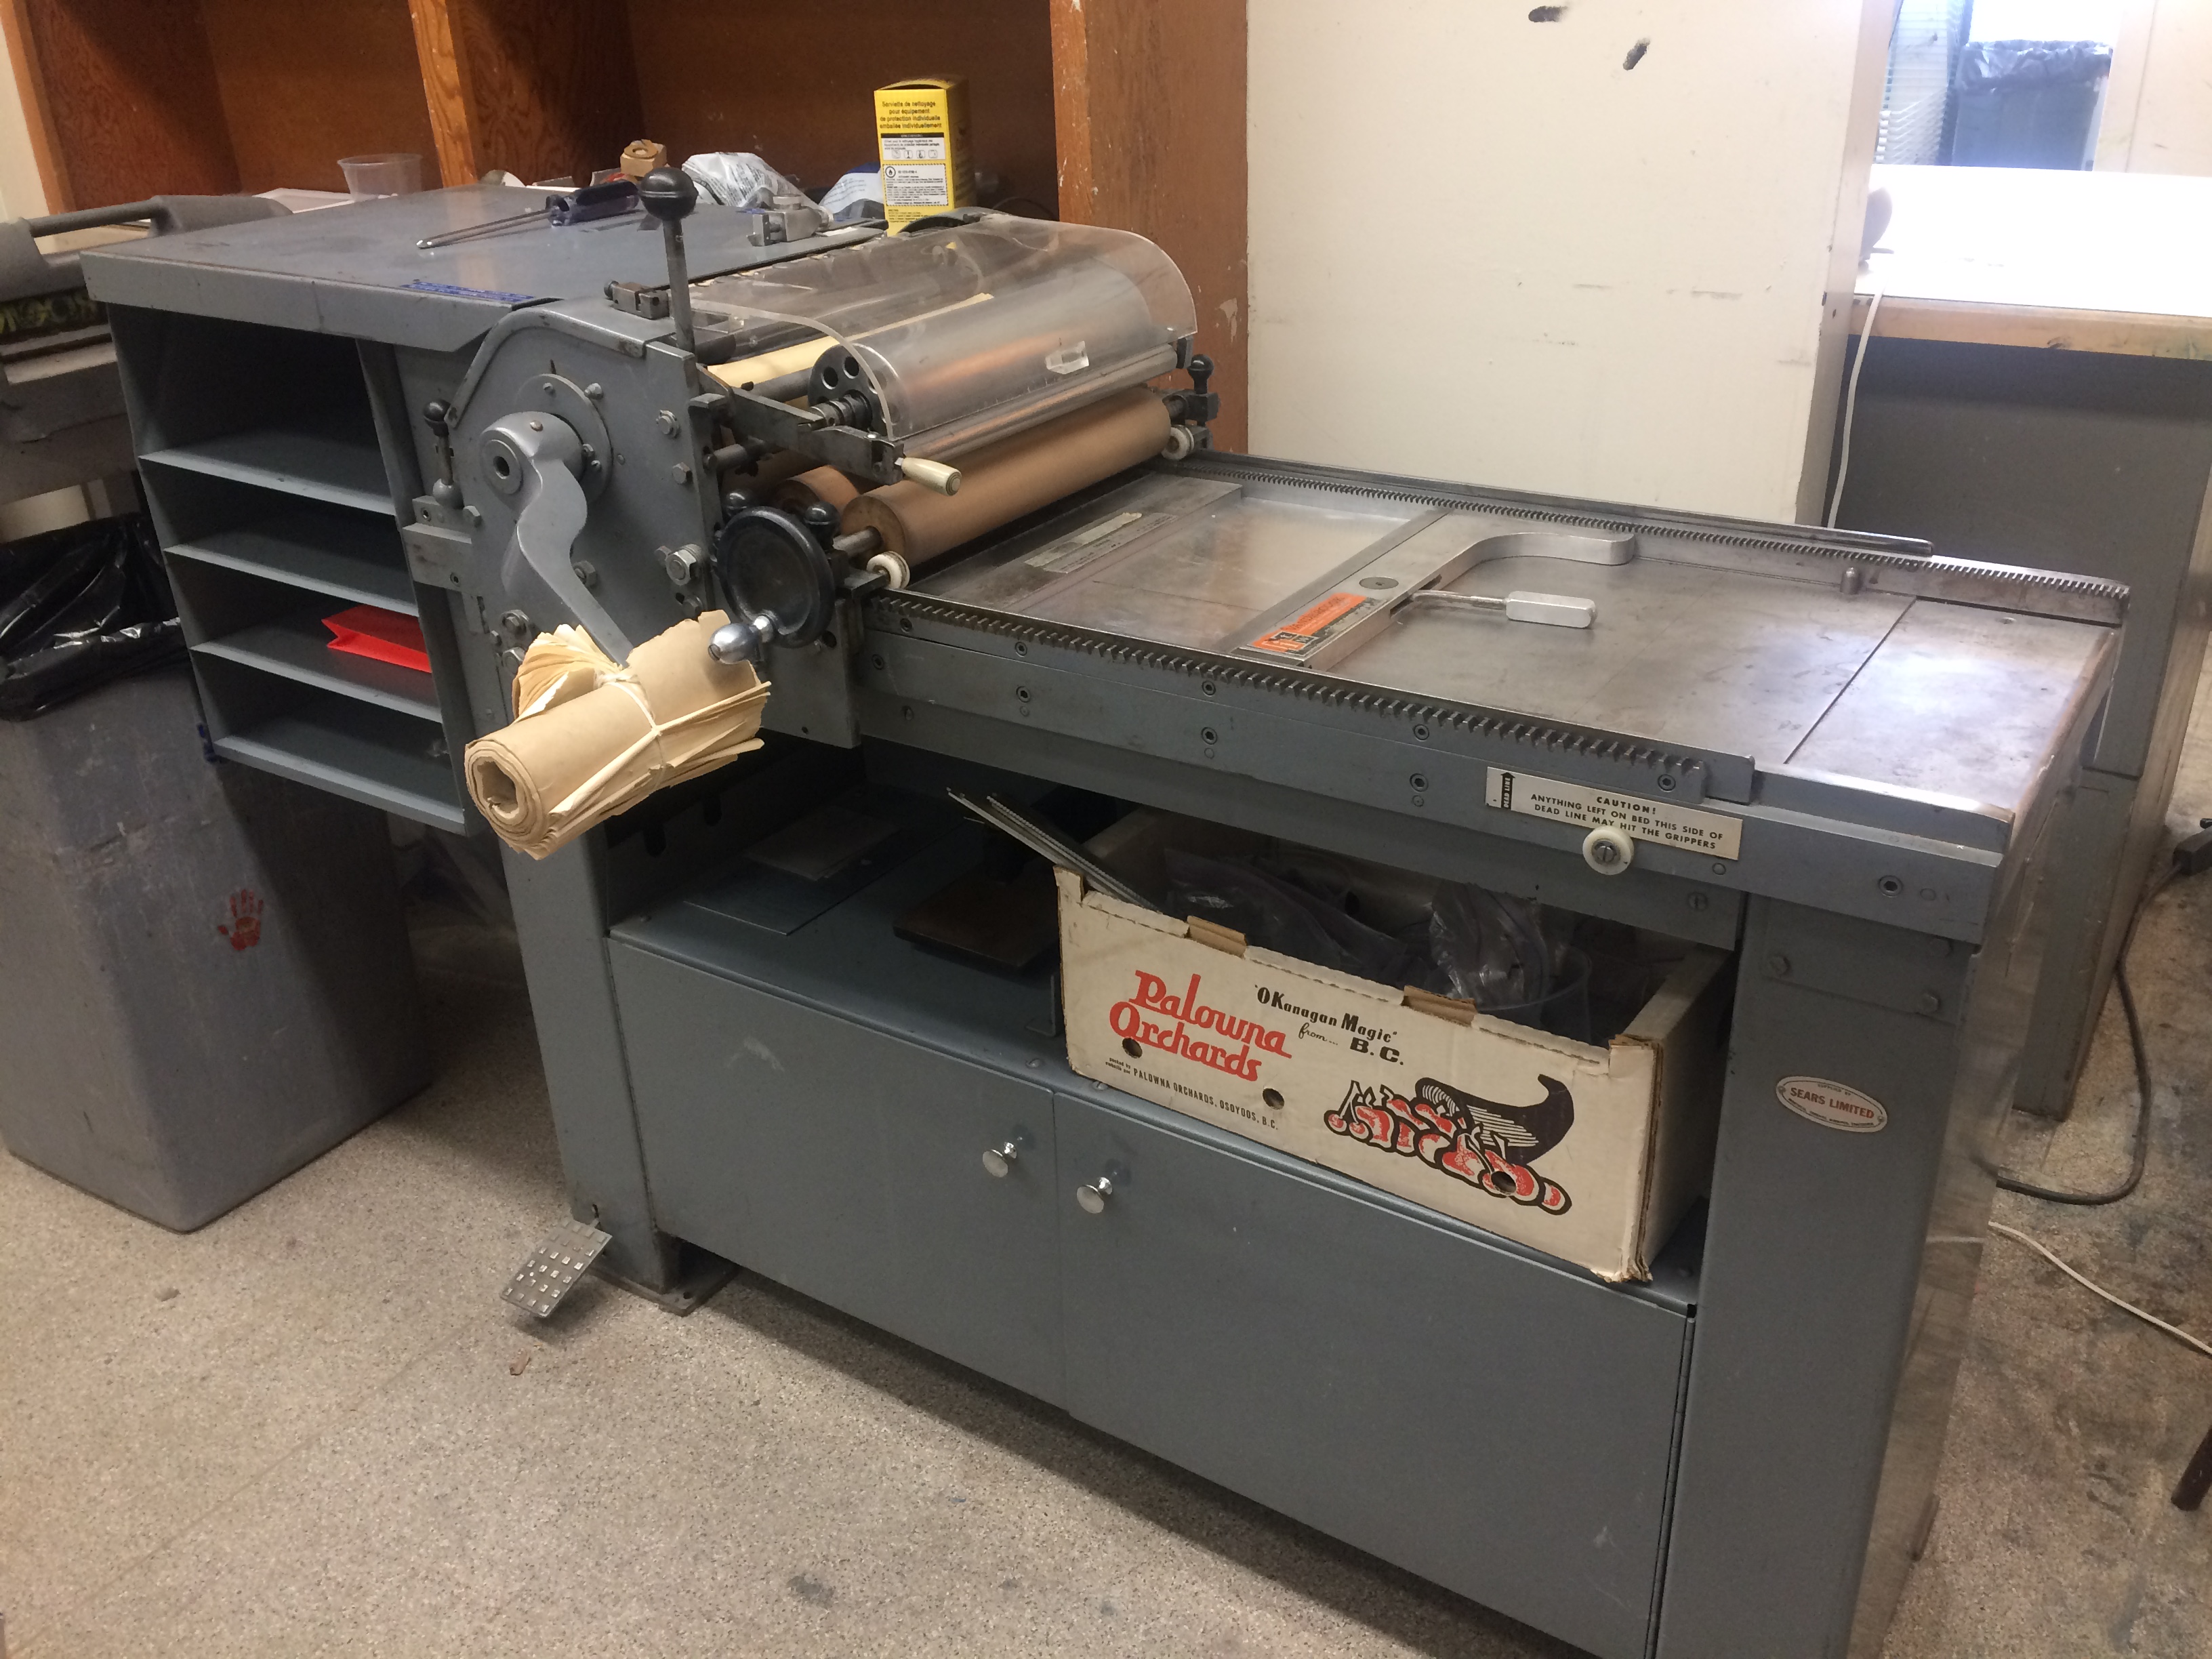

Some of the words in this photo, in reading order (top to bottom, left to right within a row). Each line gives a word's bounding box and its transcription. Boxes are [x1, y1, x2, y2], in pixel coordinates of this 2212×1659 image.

[1530, 794, 1582, 811] ANYTHING
[1587, 805, 1606, 816] LEFT
[1611, 810, 1626, 820] ON
[1631, 815, 1650, 825] BED
[1654, 819, 1677, 831] THIS
[1682, 825, 1704, 836] SIDE
[1709, 831, 1723, 840] OF
[1534, 804, 1559, 815] DEAD
[1565, 811, 1586, 821] LINE
[1592, 816, 1614, 827] MAY
[1620, 822, 1636, 832] HIT
[1641, 827, 1660, 837] THE
[1665, 832, 1716, 849] GRIPPERS
[1597, 796, 1656, 815] CAUTION!
[1128, 970, 1292, 1059] Palowna
[1109, 1001, 1262, 1082] Orchards
[1109, 1057, 1124, 1067] packed
[1133, 1068, 1170, 1089] PALOWNA
[1262, 1115, 1279, 1130] B.C.
[1790, 1087, 1826, 1105] SEARS
[1829, 1099, 1875, 1119] LIMITED
